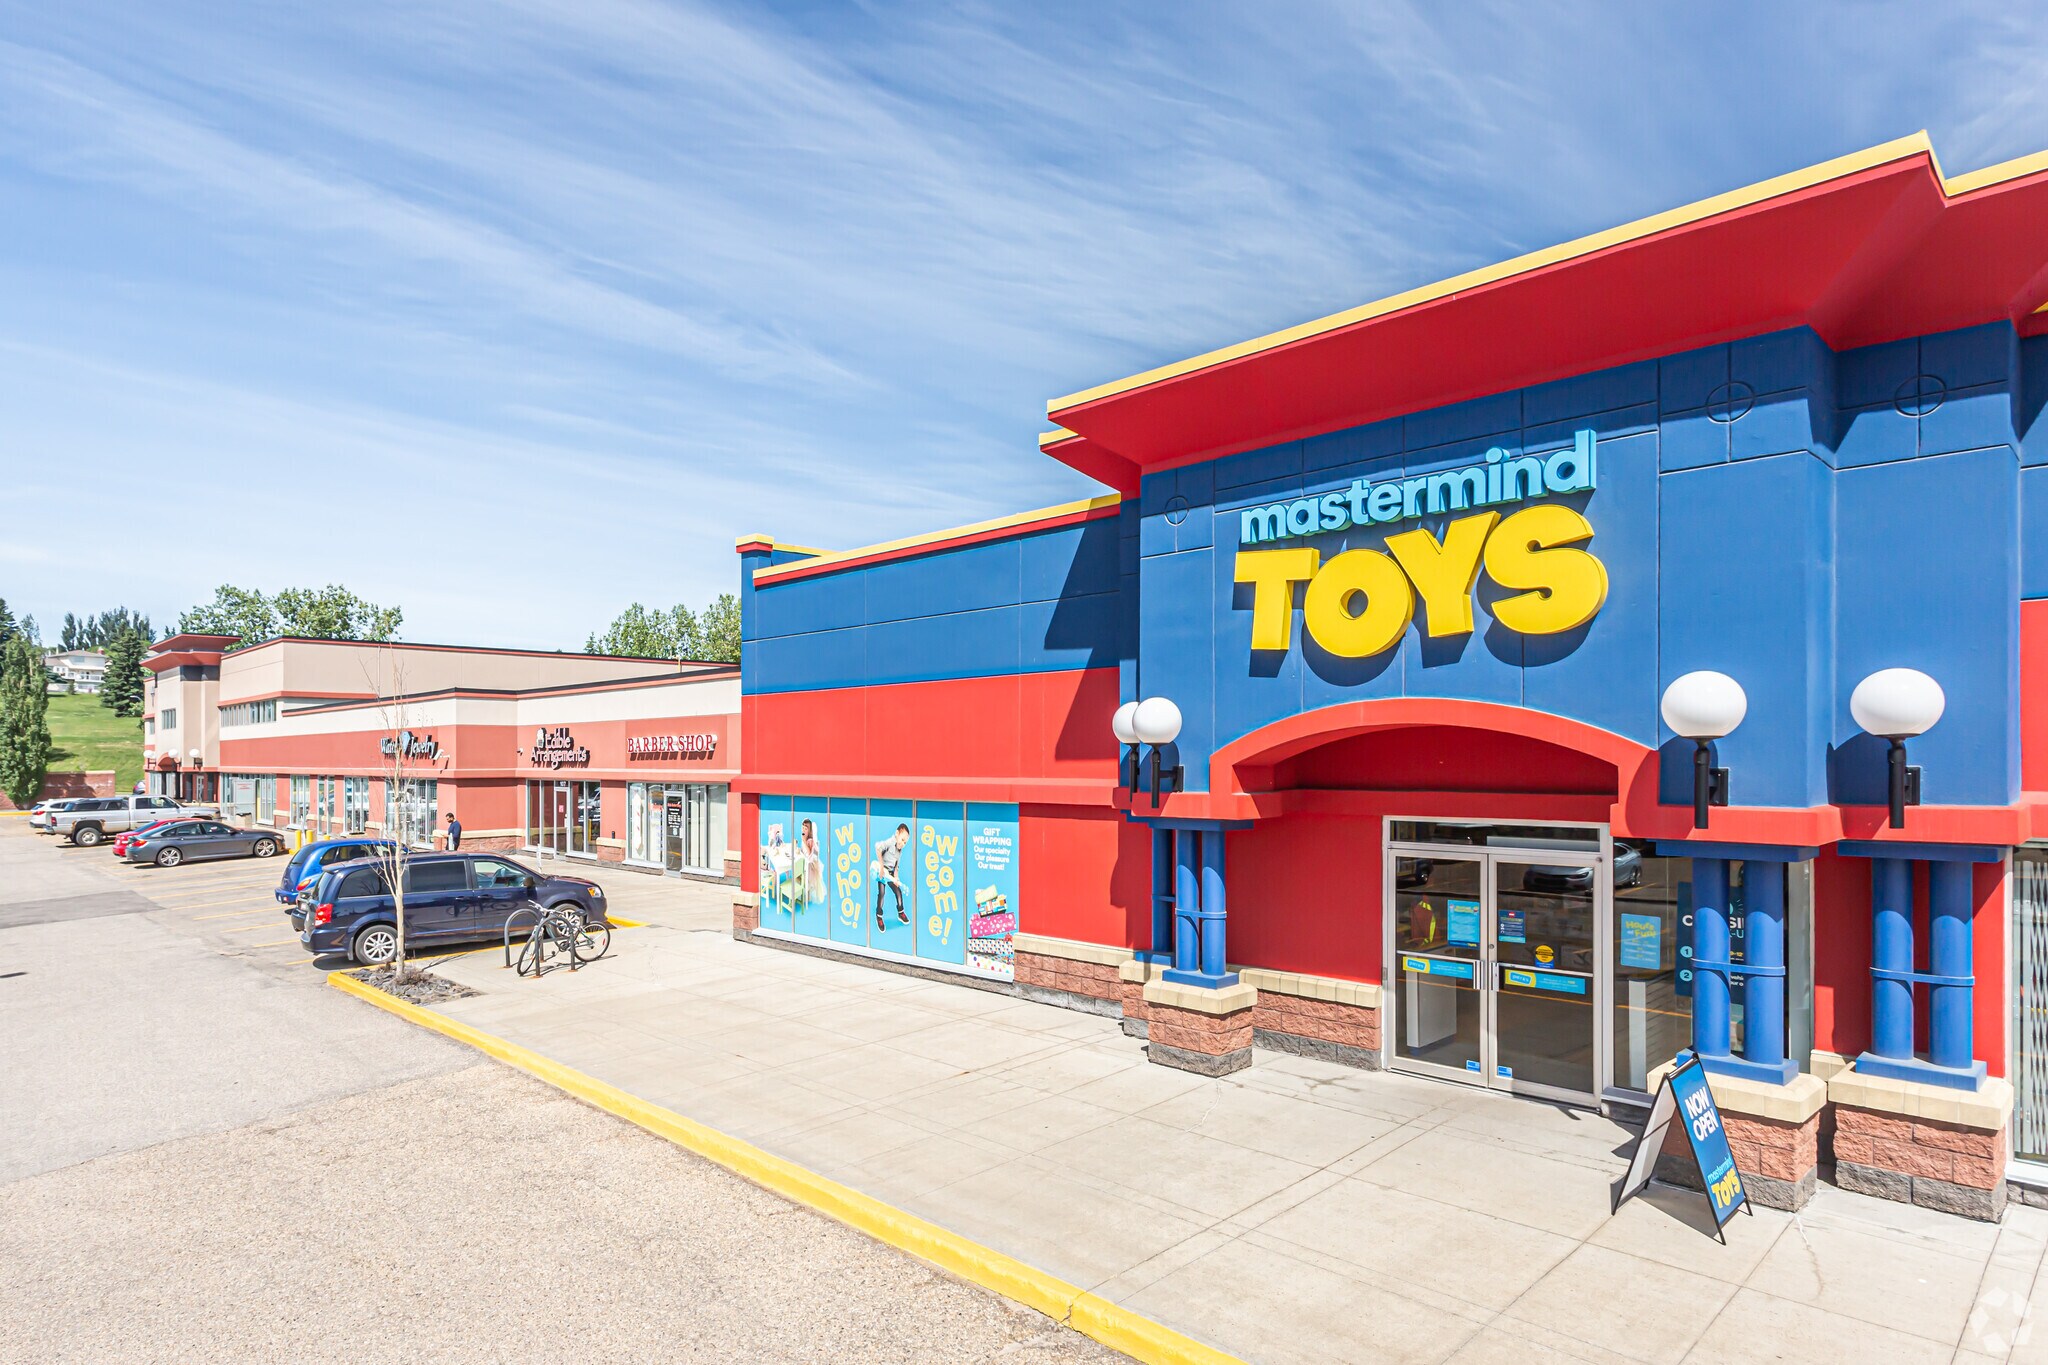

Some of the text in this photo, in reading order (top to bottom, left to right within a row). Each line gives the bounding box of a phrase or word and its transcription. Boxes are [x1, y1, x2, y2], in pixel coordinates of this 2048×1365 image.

[1241, 428, 1597, 544] mastermind
[1234, 504, 1609, 658] TOYS
[545, 727, 571, 748] Edible
[627, 734, 714, 753] BARBER SHOP
[530, 746, 587, 769] Arrangements
[972, 836, 1012, 847] WRAPPING
[983, 827, 1001, 837] GIFT
[973, 845, 985, 853] Our
[974, 853, 986, 861] Our
[977, 861, 989, 869] Our
[1684, 1086, 1710, 1119] NOW
[1692, 1108, 1719, 1142] OPEN
[1707, 1152, 1733, 1184] mastermind
[1711, 1168, 1741, 1208] TOYS
